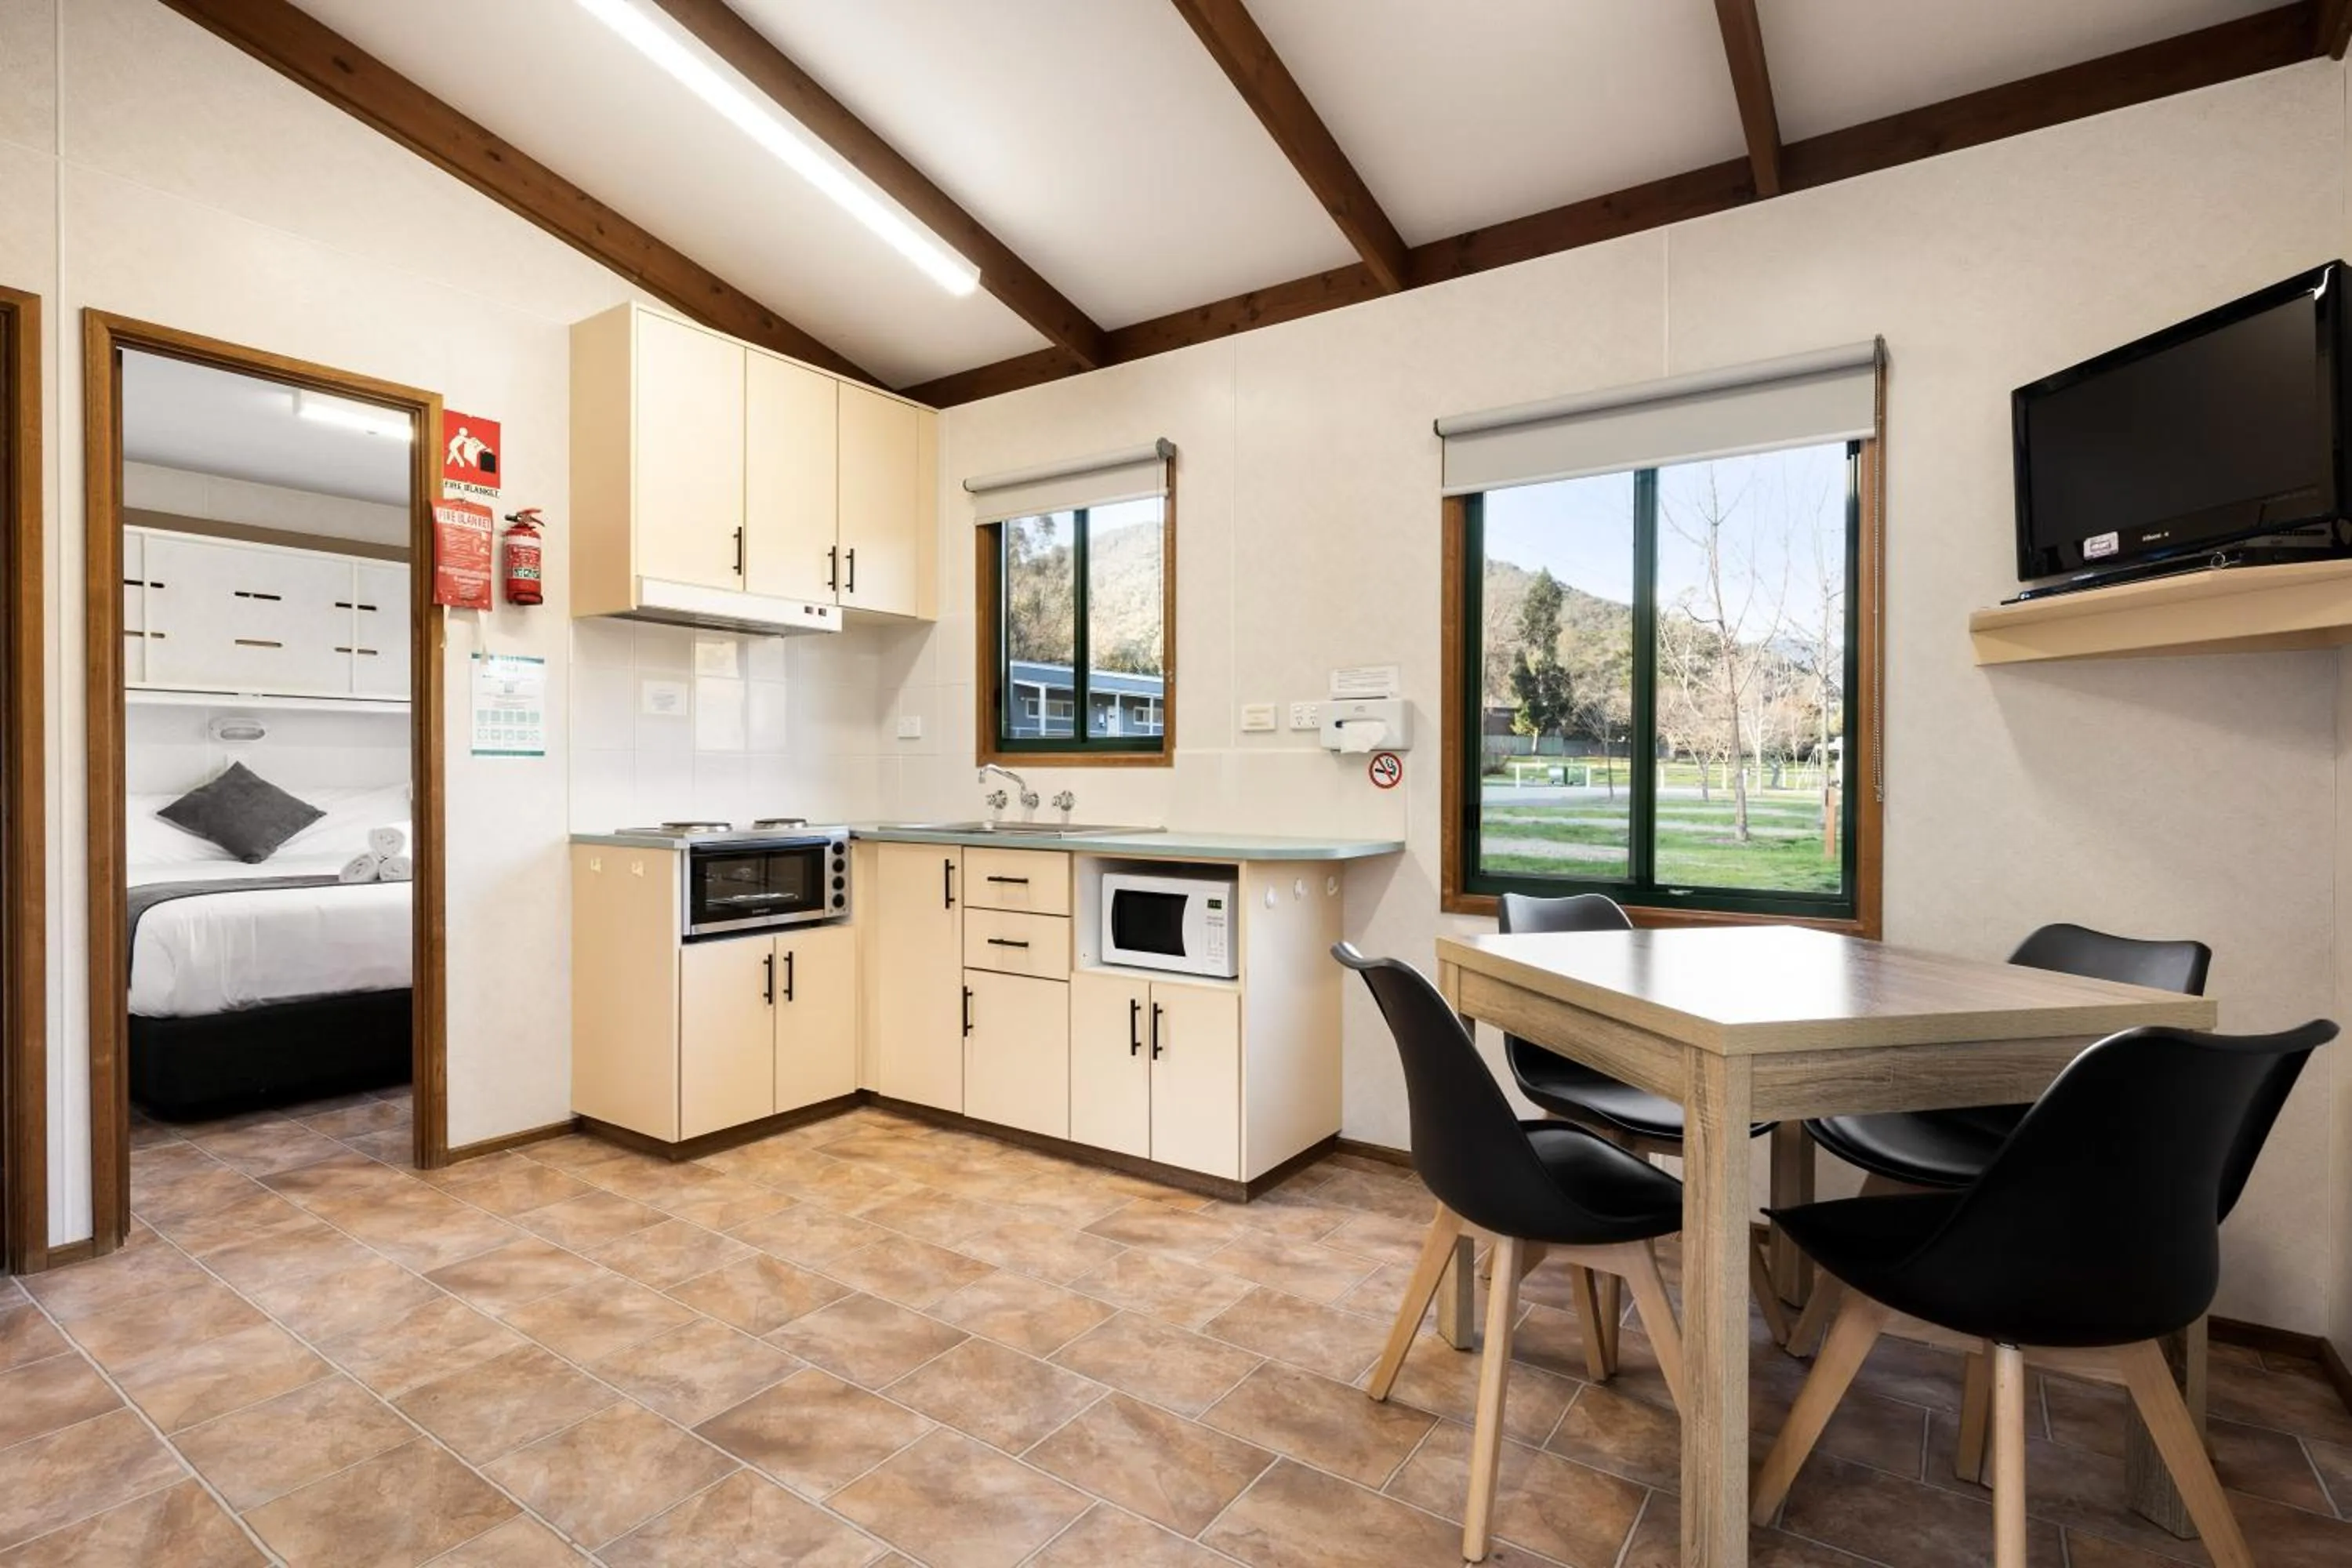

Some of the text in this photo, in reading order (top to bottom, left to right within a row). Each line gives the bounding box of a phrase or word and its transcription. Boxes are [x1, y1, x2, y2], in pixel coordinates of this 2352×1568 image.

[445, 481, 461, 490] FIRE
[438, 509, 490, 529] FIRE BLANKET
